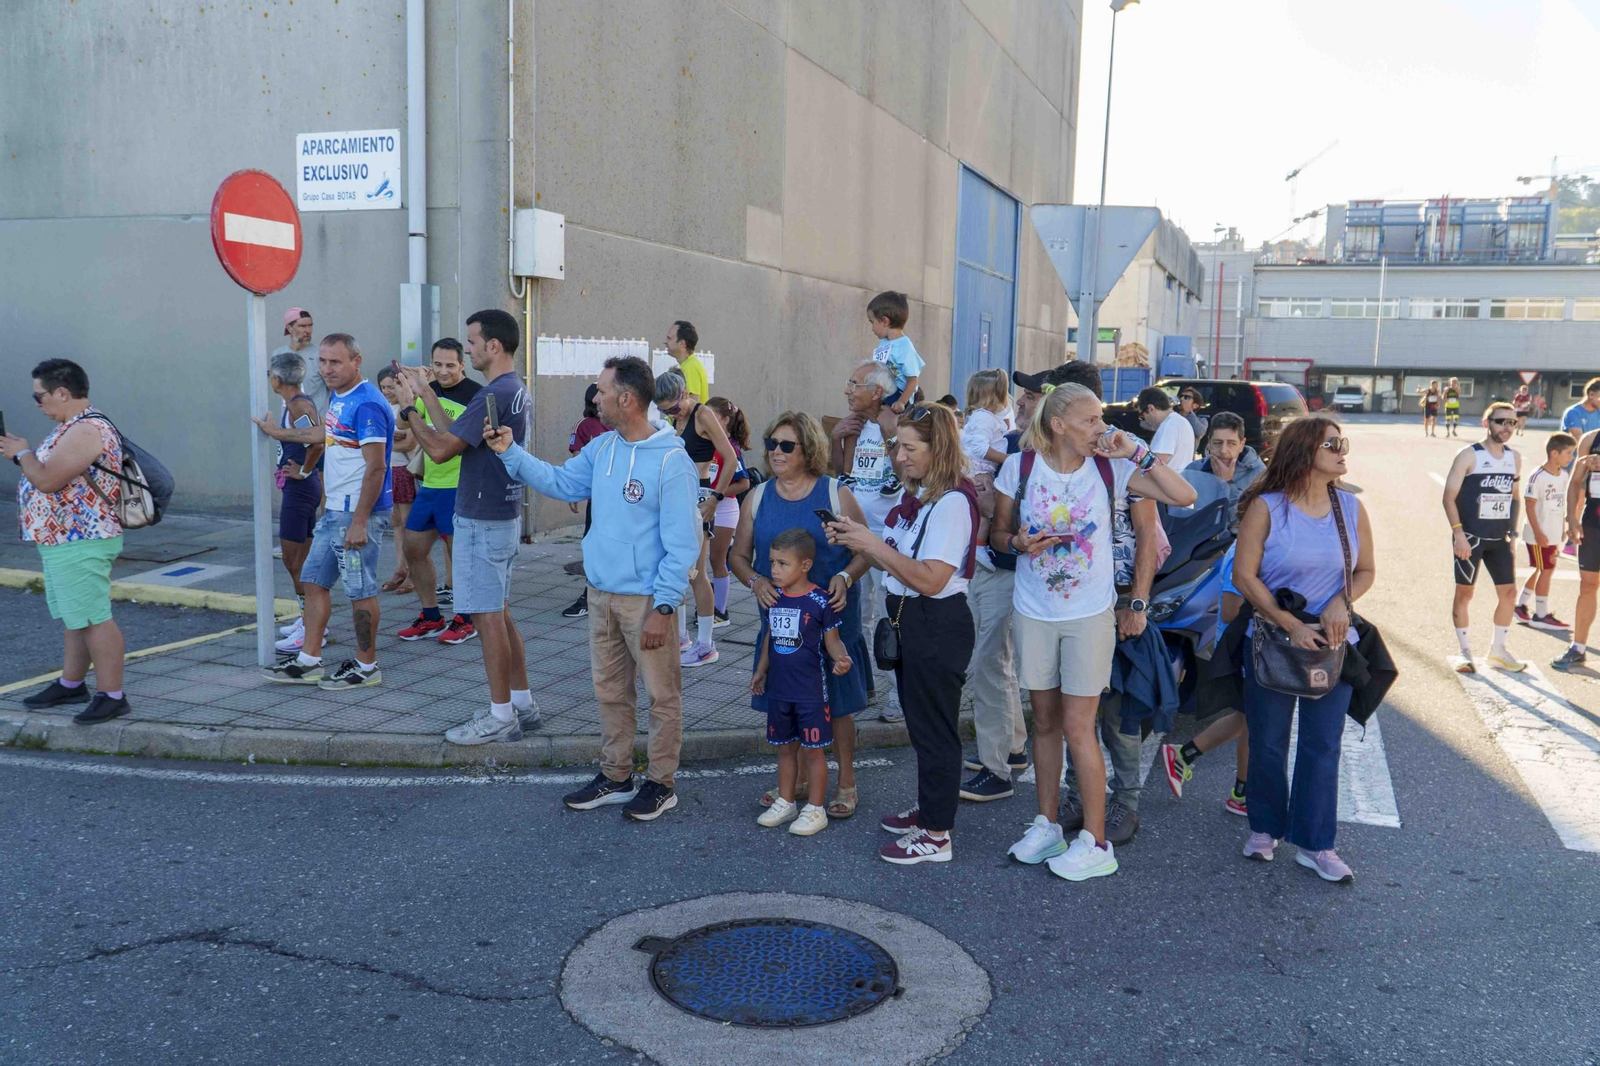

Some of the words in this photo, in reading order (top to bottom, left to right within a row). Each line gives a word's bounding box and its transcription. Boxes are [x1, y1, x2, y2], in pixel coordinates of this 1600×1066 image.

[302, 136, 395, 155] APARCAMIENTO
[303, 163, 369, 181] EXCLUSIVO
[302, 192, 320, 202] Grupo
[321, 192, 335, 201] Casa
[337, 191, 356, 200] BOTAS
[857, 456, 878, 468] 607
[1491, 501, 1505, 512] 46
[772, 616, 791, 629] 813
[803, 727, 820, 742] 10
